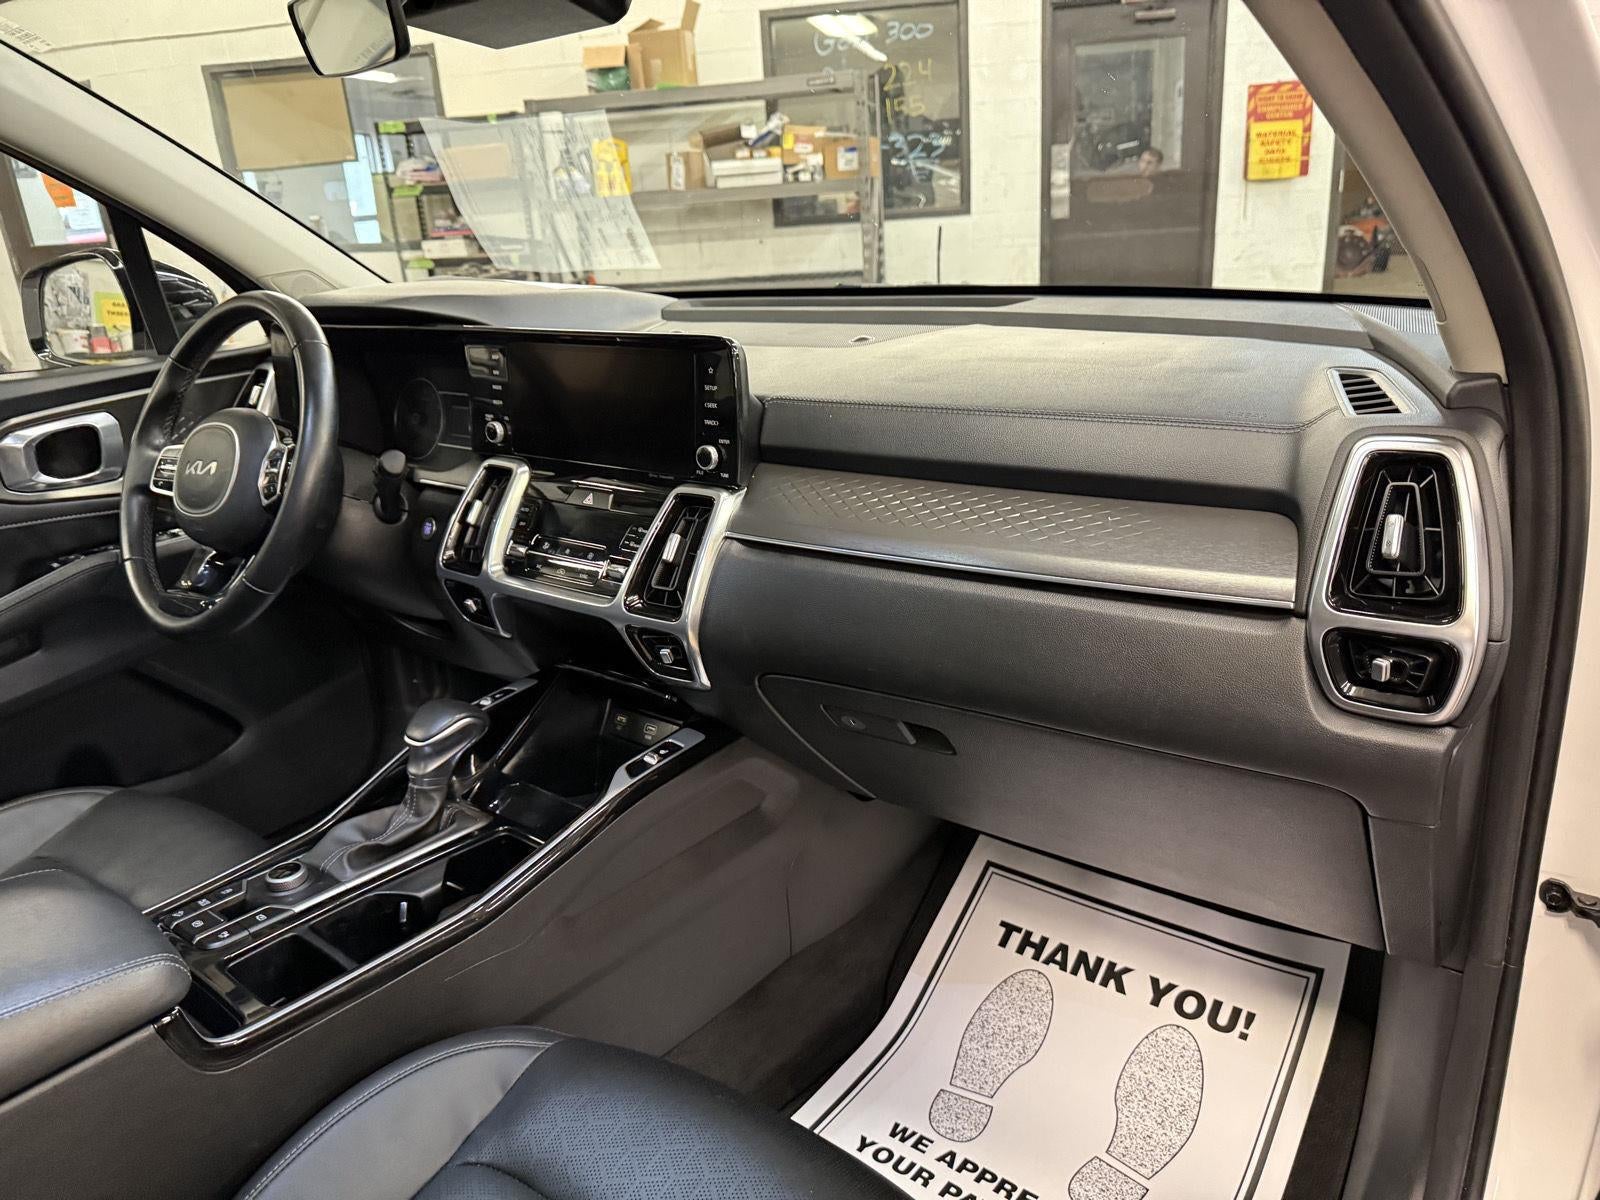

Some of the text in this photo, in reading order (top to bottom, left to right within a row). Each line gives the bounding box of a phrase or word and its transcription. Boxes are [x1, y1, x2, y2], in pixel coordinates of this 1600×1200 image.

[885, 20, 934, 44] 300
[883, 58, 932, 91] 224
[997, 920, 1257, 1041] THANK YOU!
[855, 1134, 936, 1188] YOUR
[888, 1121, 1040, 1200] WE APPRE
